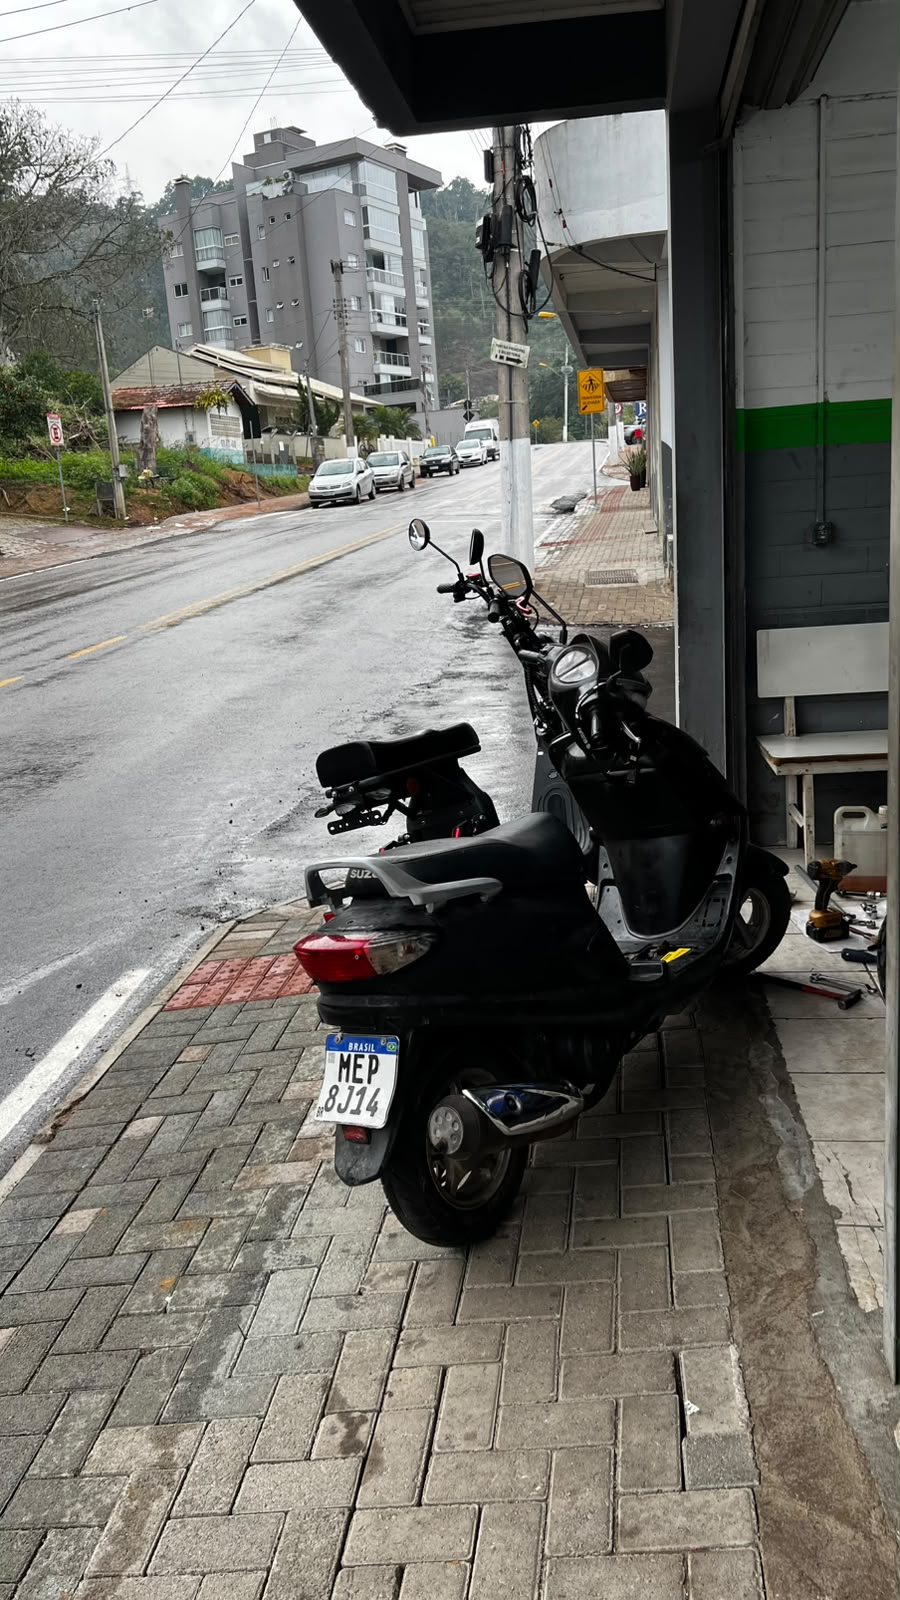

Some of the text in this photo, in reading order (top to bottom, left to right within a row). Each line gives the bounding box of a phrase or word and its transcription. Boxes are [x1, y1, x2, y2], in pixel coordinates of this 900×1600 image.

[348, 1042, 375, 1052] BRASIL
[338, 1053, 380, 1085] MEP
[324, 1084, 381, 1117] 8J14
